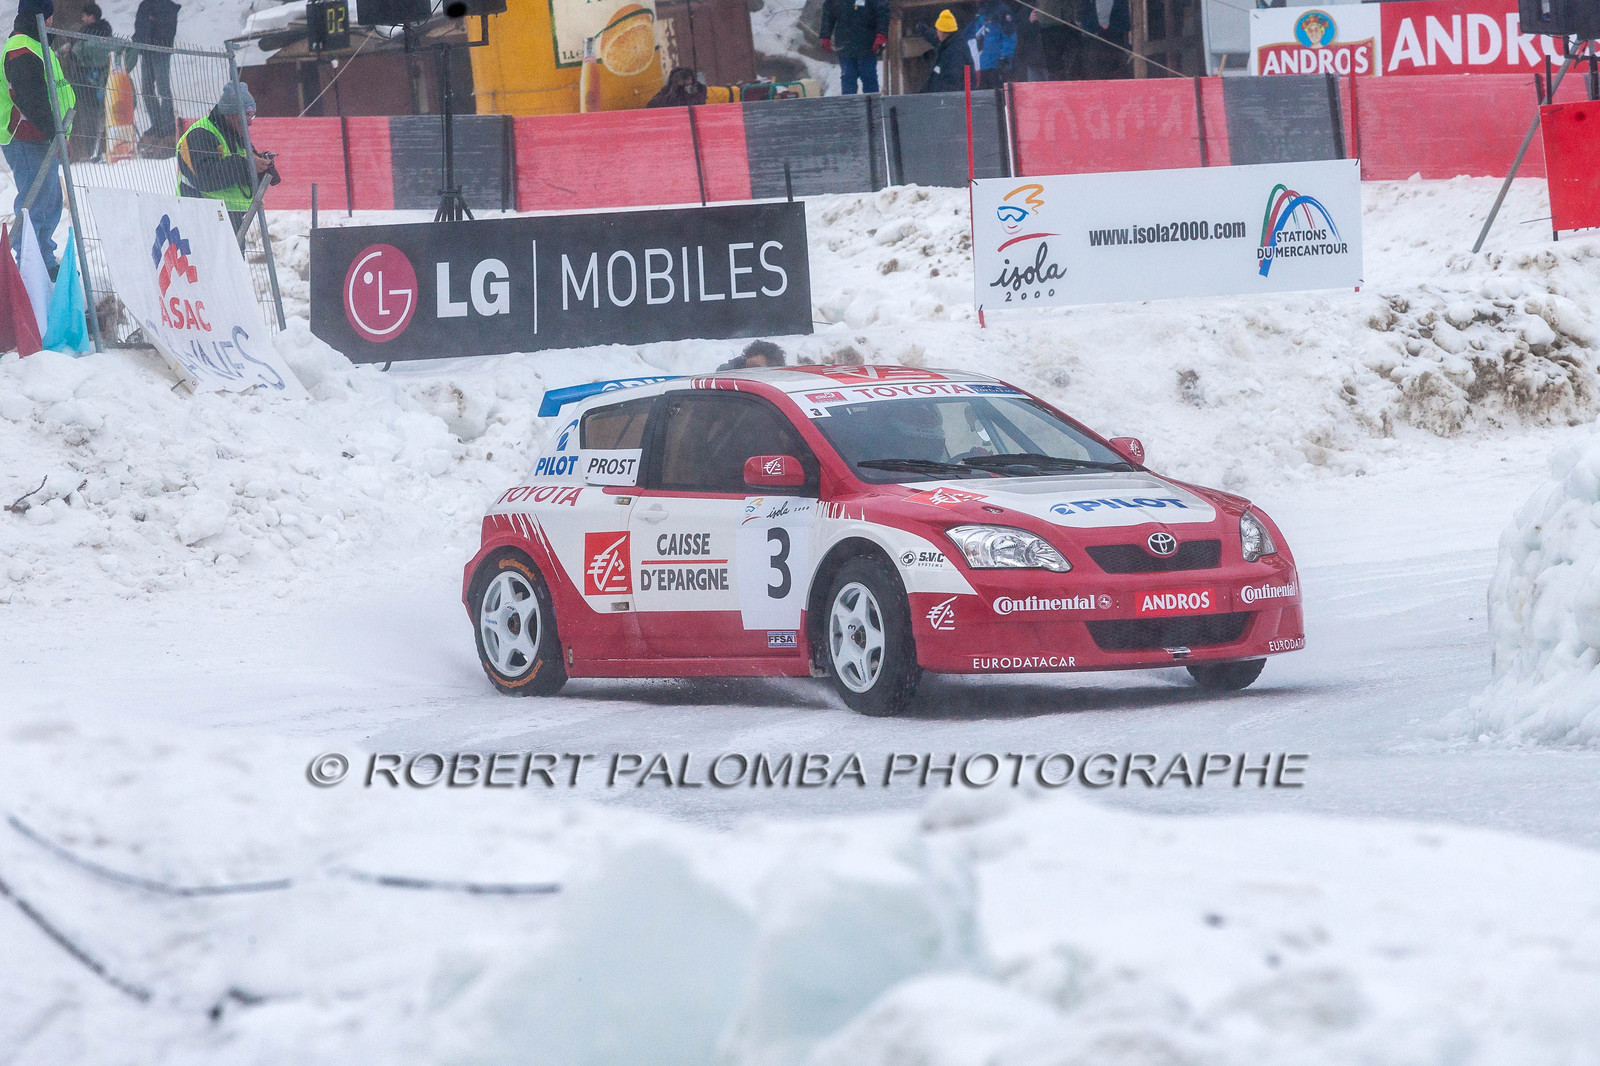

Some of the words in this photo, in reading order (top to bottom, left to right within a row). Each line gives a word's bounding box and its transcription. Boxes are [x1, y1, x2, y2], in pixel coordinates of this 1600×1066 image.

[1263, 45, 1369, 75] ANDROS
[1089, 221, 1246, 246] www.isola2000.com
[1276, 229, 1327, 243] STATIONS
[1257, 249, 1274, 260] DU
[1275, 242, 1348, 258] MERCANTOUR
[990, 241, 1067, 287] isola
[436, 258, 510, 319] LG
[561, 240, 788, 311] MOBILES
[1005, 288, 1055, 302] 2000
[158, 296, 213, 332] ASAC
[852, 384, 975, 399] TOYOTA
[535, 455, 579, 476] PILOT
[586, 457, 636, 476] PROST
[497, 486, 582, 507] TOYOTA
[1072, 497, 1190, 512] PILOT
[656, 533, 711, 557] CAISSE
[766, 526, 792, 600] 3
[640, 567, 729, 592] D'EPARGNE
[1141, 591, 1211, 612] ANDROS
[1240, 581, 1296, 604] Continental
[992, 594, 1096, 616] Continental
[973, 655, 1076, 670] EURODATACAR
